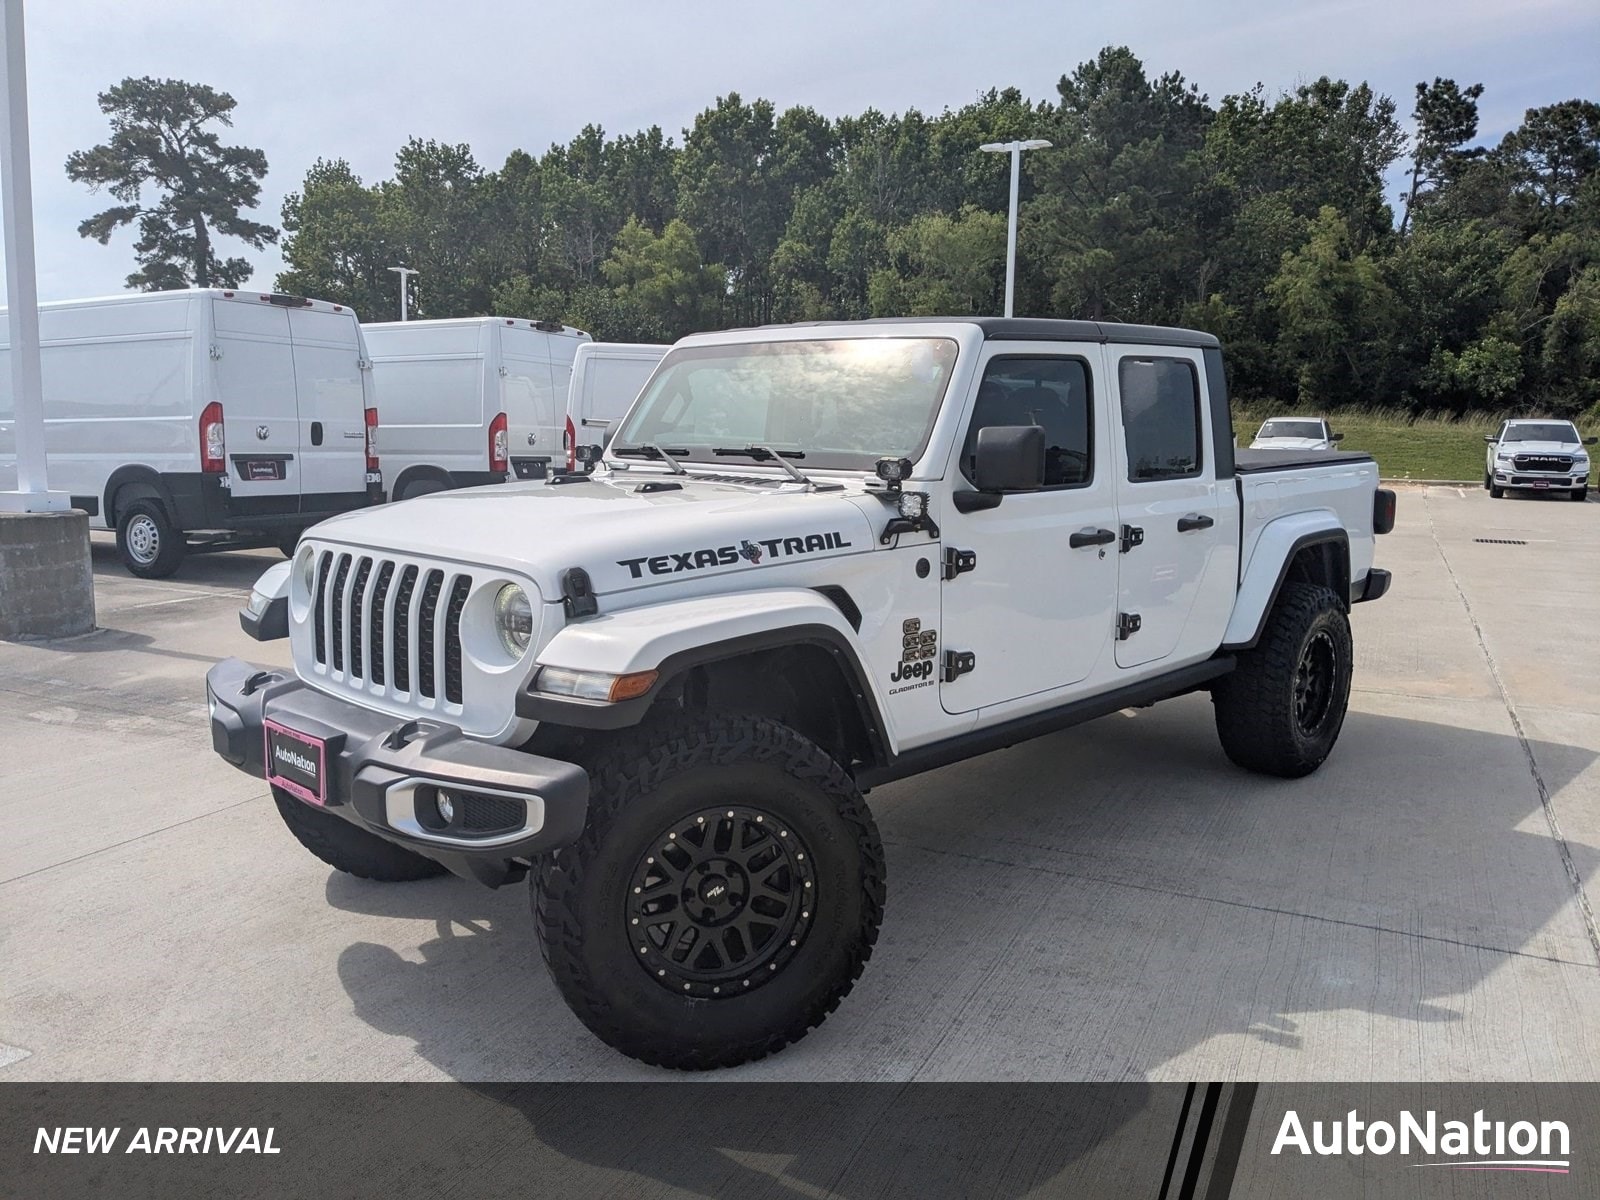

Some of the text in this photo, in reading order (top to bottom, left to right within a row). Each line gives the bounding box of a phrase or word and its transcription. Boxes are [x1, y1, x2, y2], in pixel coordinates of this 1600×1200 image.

[616, 531, 852, 579] TEXAS TRAIL
[890, 660, 933, 682] Jeep
[889, 681, 928, 695] GLADIATOR
[275, 745, 316, 773] AutoNation
